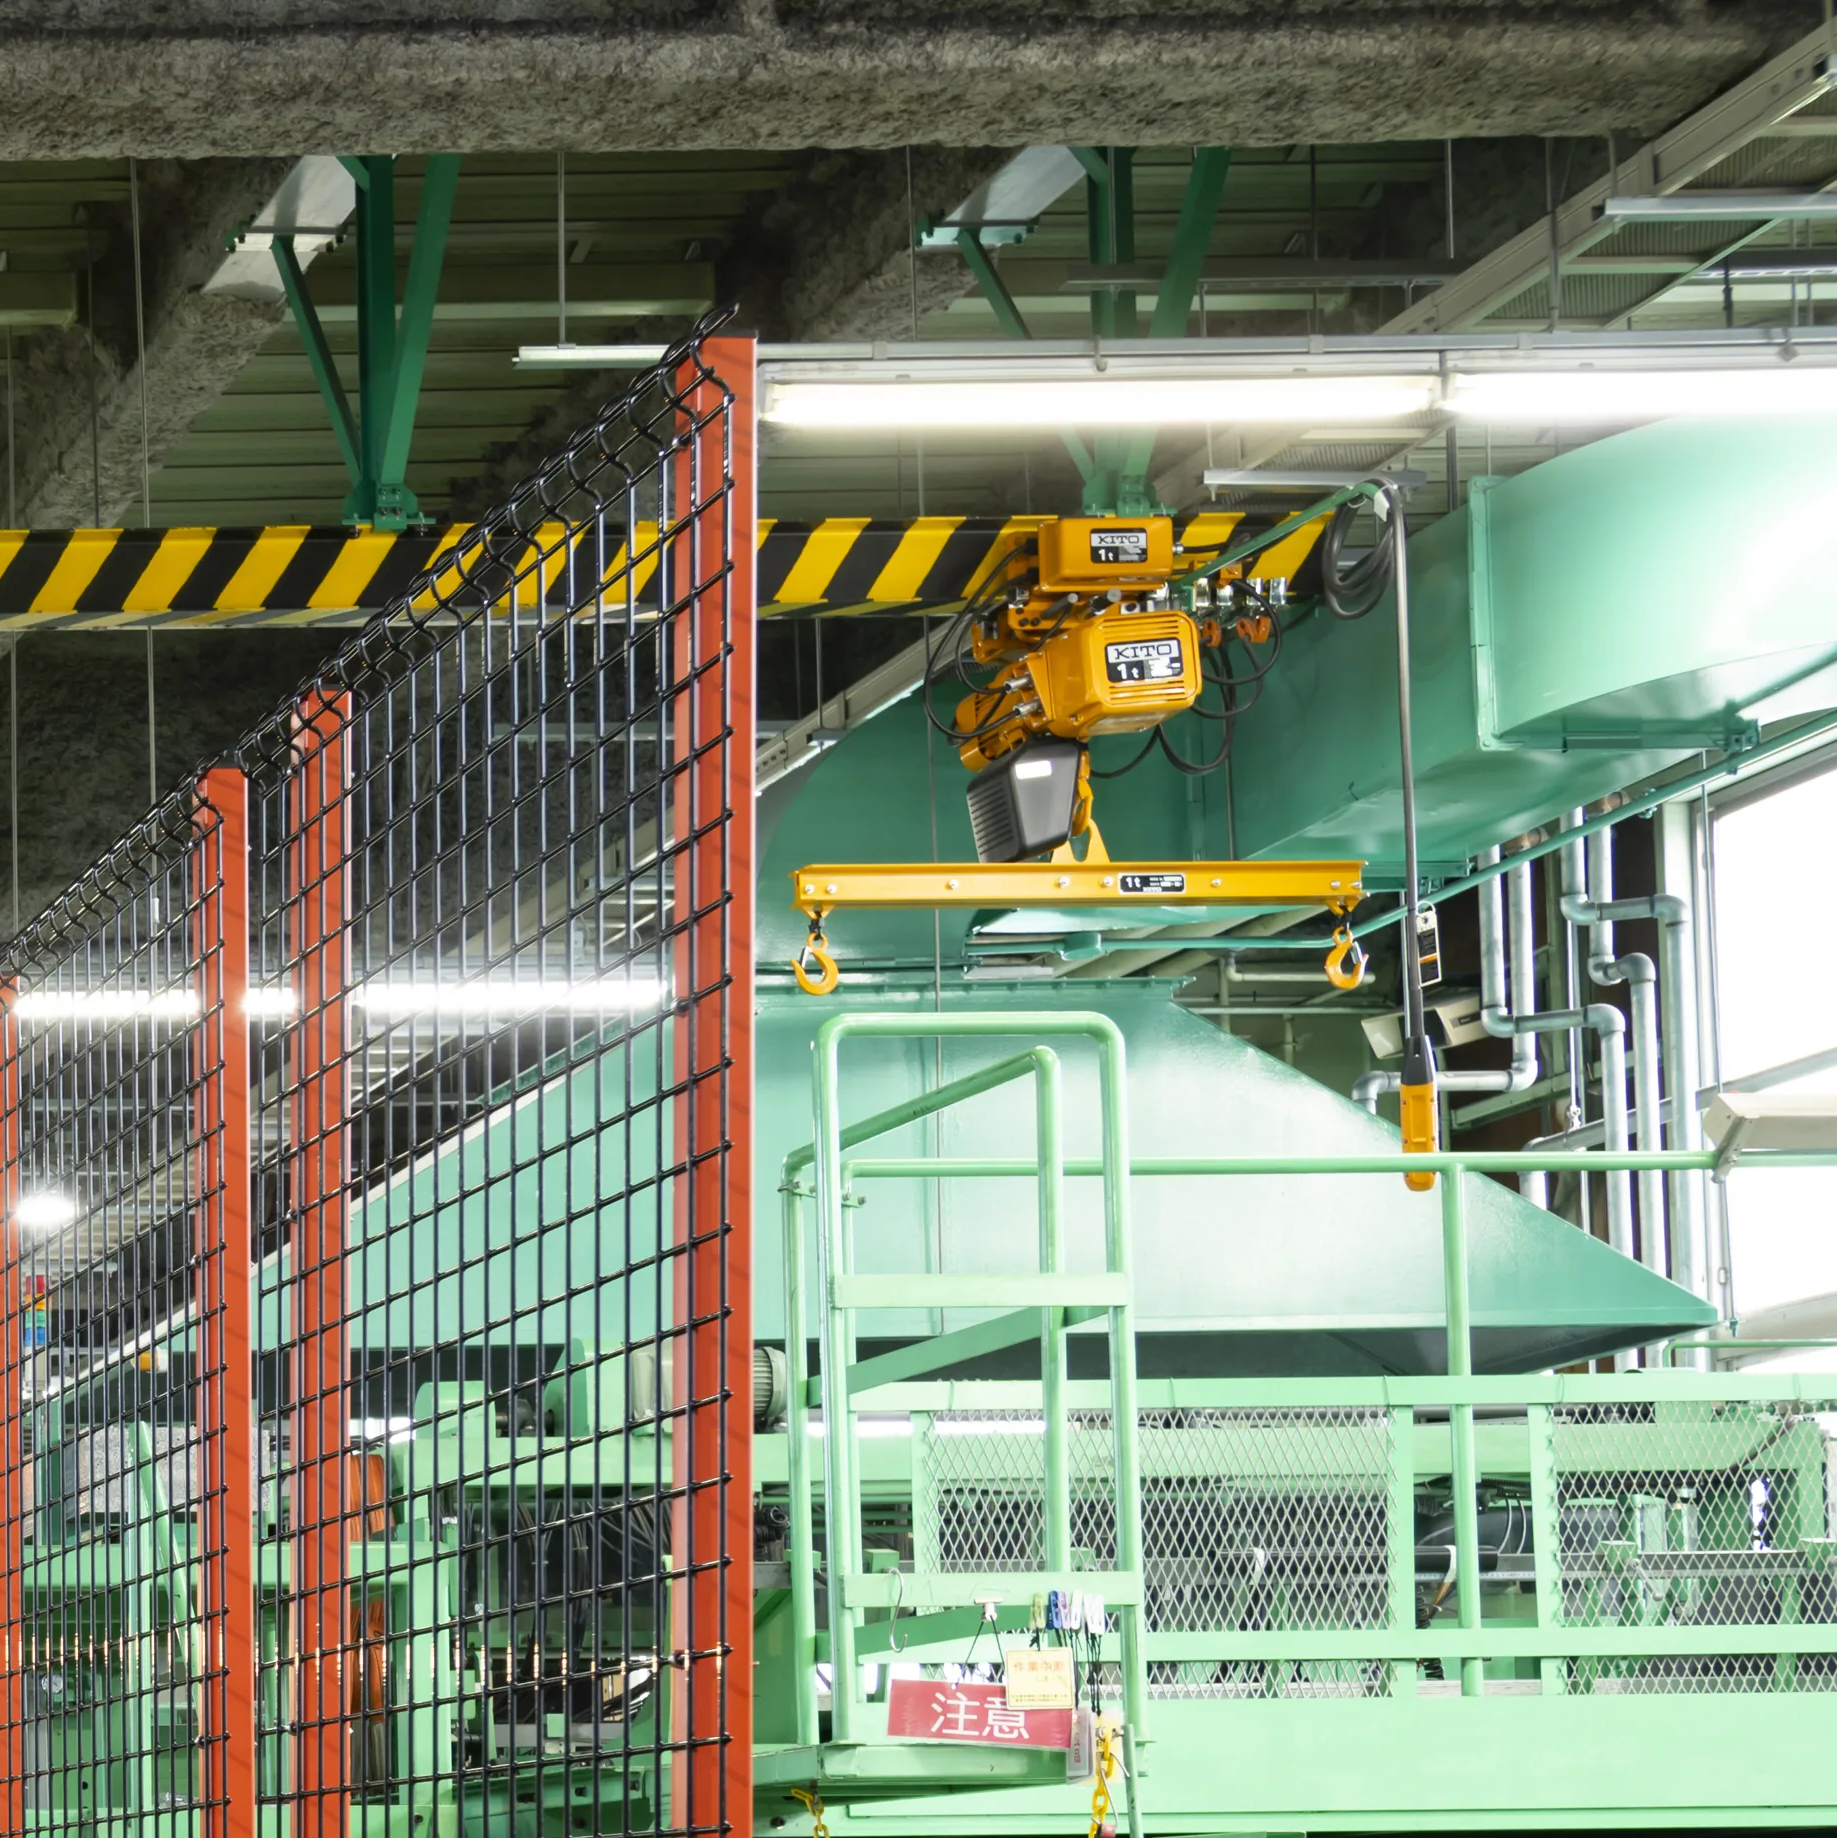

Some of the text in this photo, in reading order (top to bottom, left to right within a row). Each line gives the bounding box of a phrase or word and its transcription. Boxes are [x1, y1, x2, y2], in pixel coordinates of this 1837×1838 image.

[1098, 535, 1140, 545] KITO
[1114, 643, 1172, 660] KITO
[930, 1691, 1030, 1740] 注意
